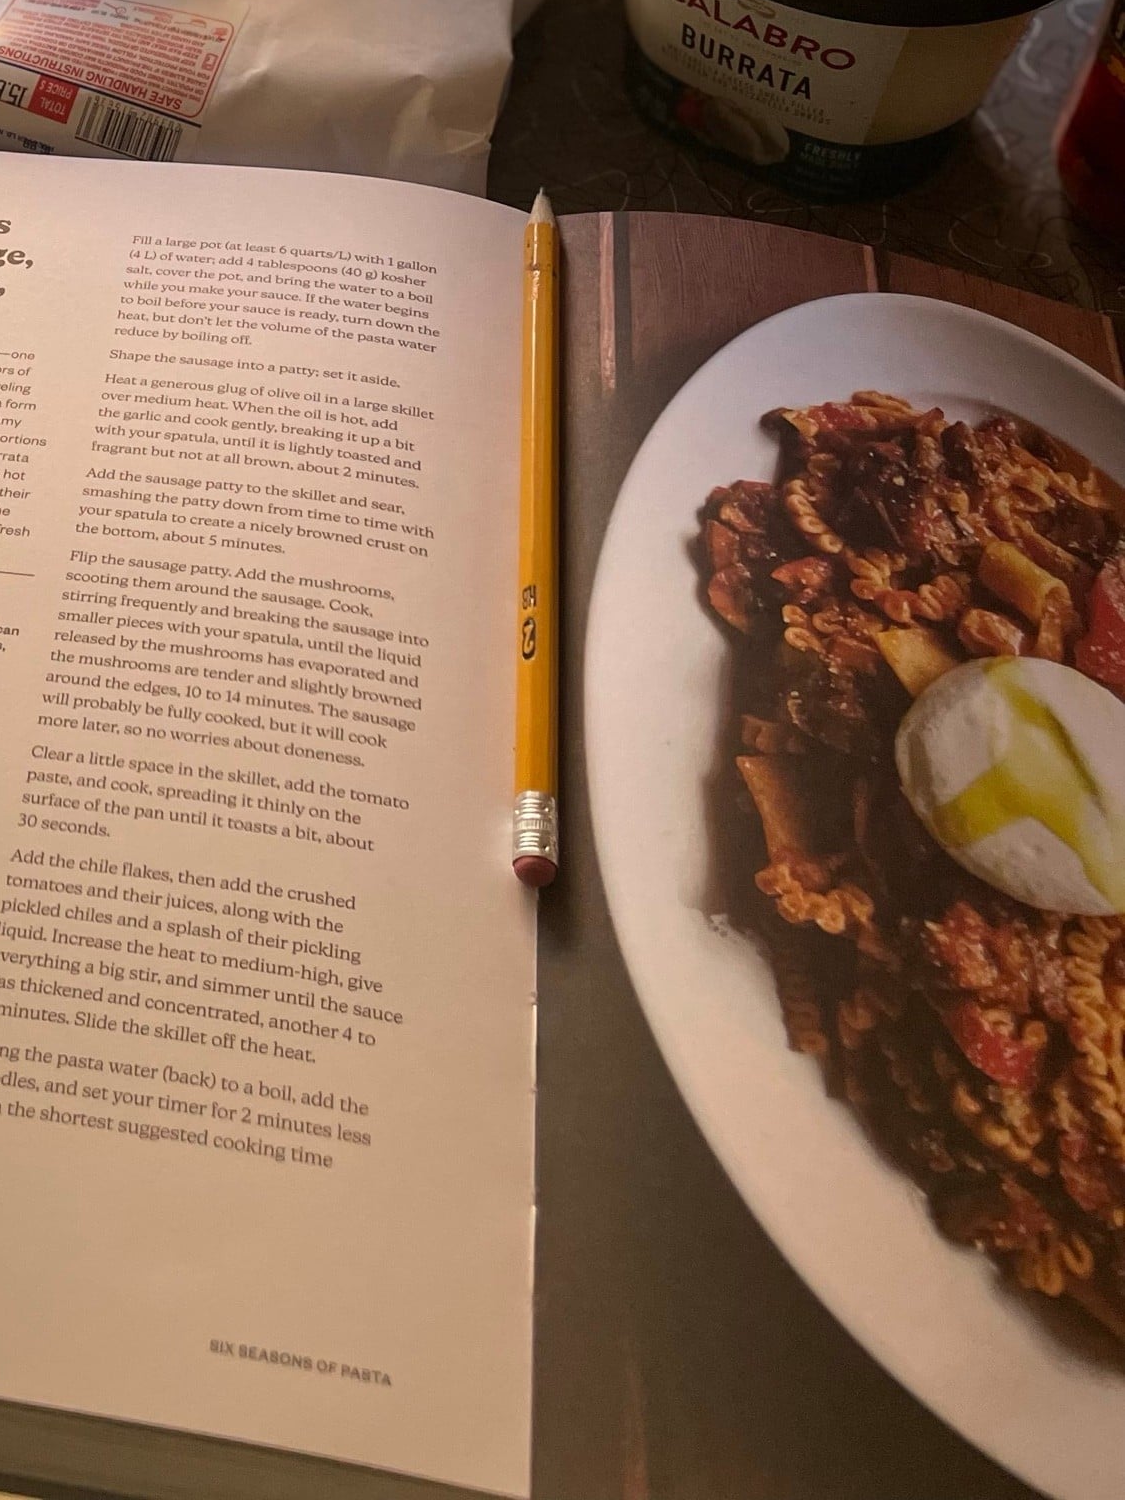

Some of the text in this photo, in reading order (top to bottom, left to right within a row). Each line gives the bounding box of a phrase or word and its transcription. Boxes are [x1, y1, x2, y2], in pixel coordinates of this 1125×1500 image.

[681, 23, 811, 100] BURRATA
[47, 81, 72, 98] PRICE
[86, 71, 148, 99] HANDLING
[148, 92, 183, 109] SAFE
[40, 97, 66, 115] TOTAL
[132, 235, 437, 275] Fill a large pot (at least 6 quarts/L) with 1 gallon
[17, 366, 32, 377] of
[109, 349, 401, 389] Shape the sausage into a patty; set it aside.
[69, 549, 395, 601] Flip the sausage patty. Add the mushrooms,
[7, 1100, 36, 1119] the
[39, 1105, 114, 1131] shortest
[117, 1120, 208, 1146] suggested
[212, 1135, 286, 1162] cooking
[291, 1146, 333, 1168] time
[209, 1339, 392, 1387] SIX SEASONS OF PASTA
